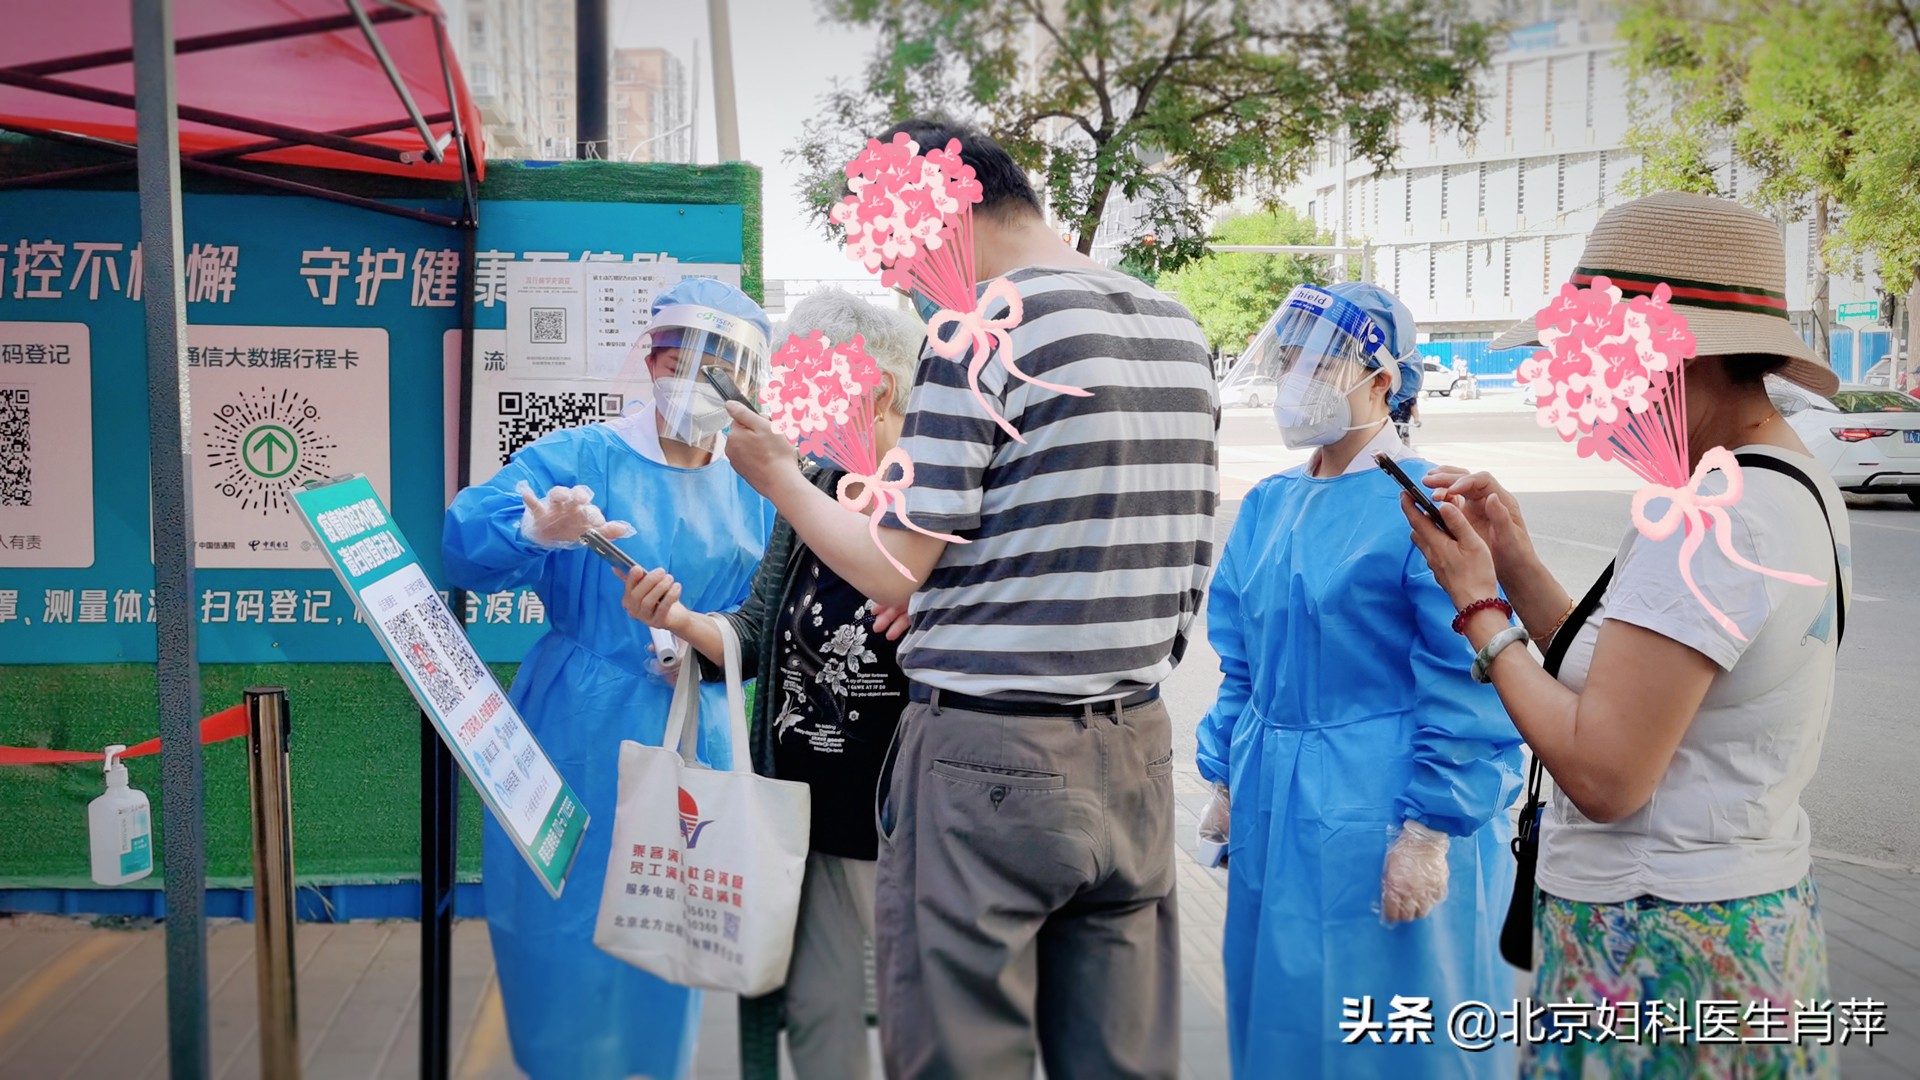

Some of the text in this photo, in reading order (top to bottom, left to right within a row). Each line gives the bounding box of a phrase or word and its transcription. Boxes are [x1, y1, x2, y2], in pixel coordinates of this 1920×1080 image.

[187, 346, 359, 370] 通信大数据行程卡
[484, 350, 507, 372] 流
[316, 498, 388, 544] 疫情防控不松懈
[198, 541, 236, 550] 中国信通院
[336, 529, 406, 578] 请扫码登记进入
[633, 844, 683, 864] 乘客满
